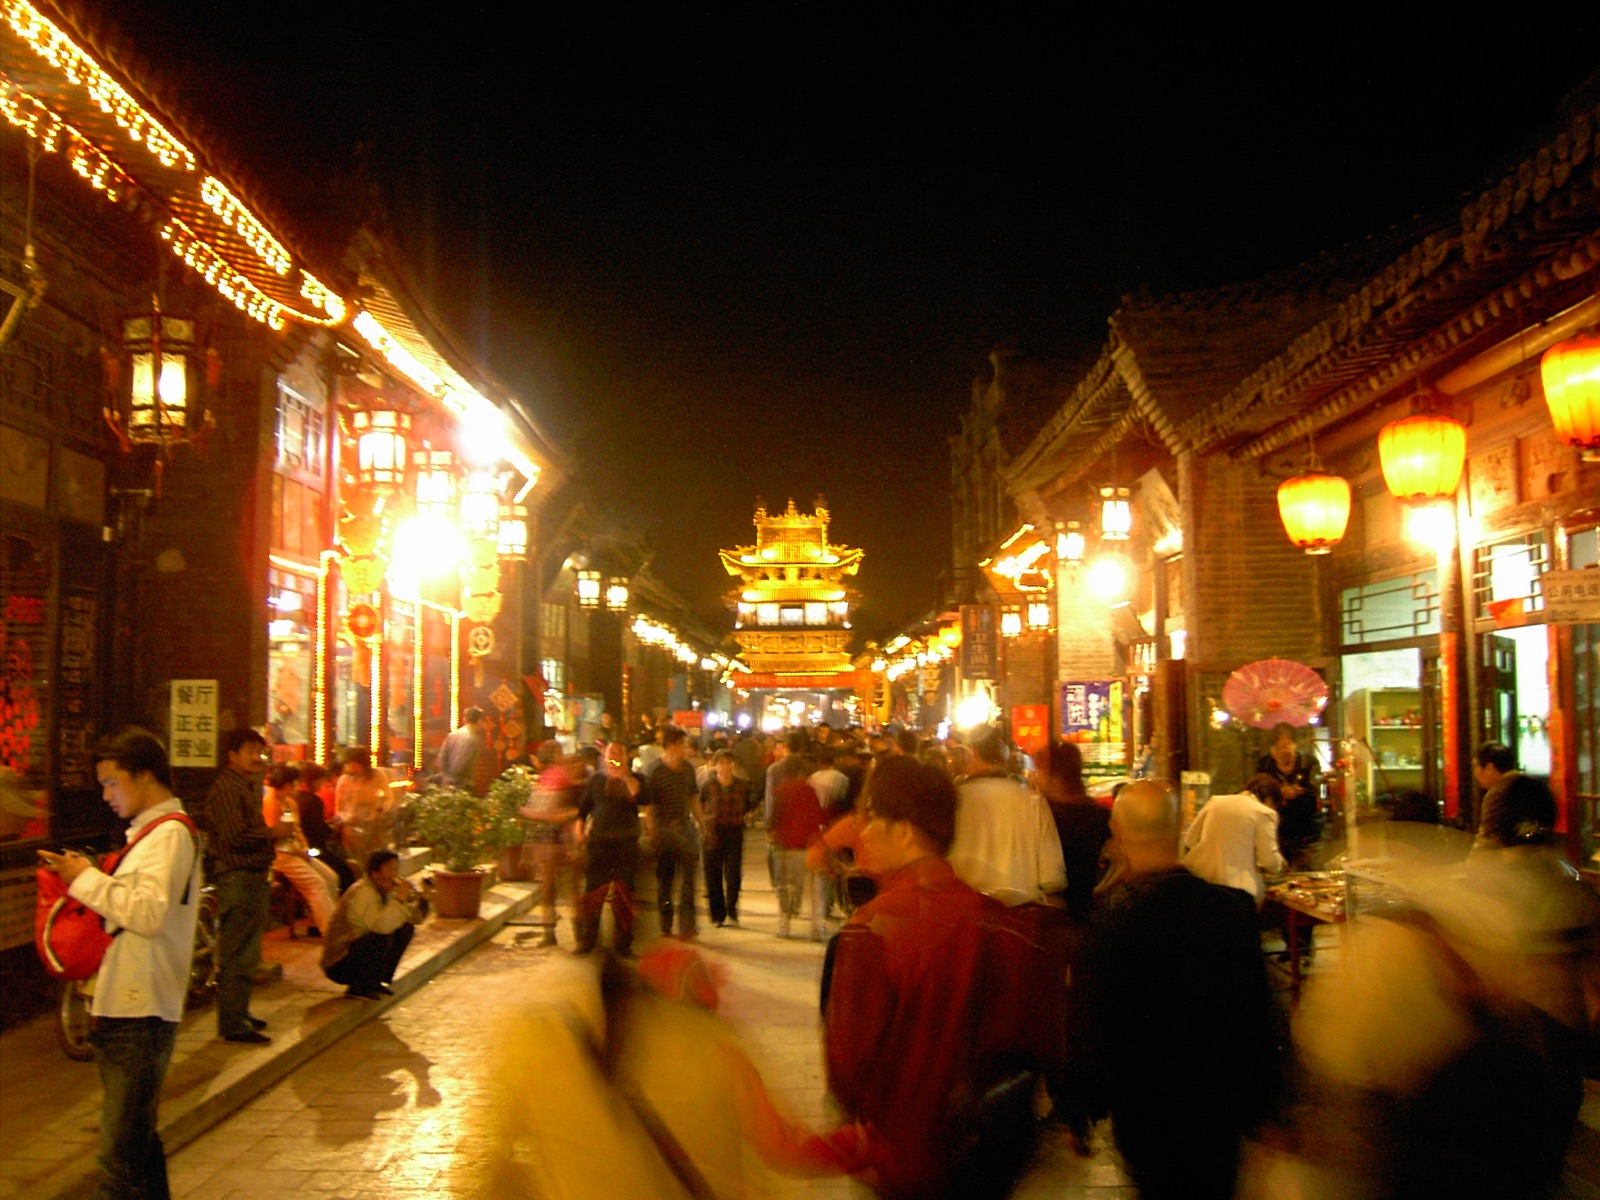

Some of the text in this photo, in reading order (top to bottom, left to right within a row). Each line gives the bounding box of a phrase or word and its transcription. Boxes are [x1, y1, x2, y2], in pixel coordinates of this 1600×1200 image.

[176, 686, 213, 704] 餐厅
[175, 714, 214, 732] 正在
[174, 738, 213, 758] 营业
